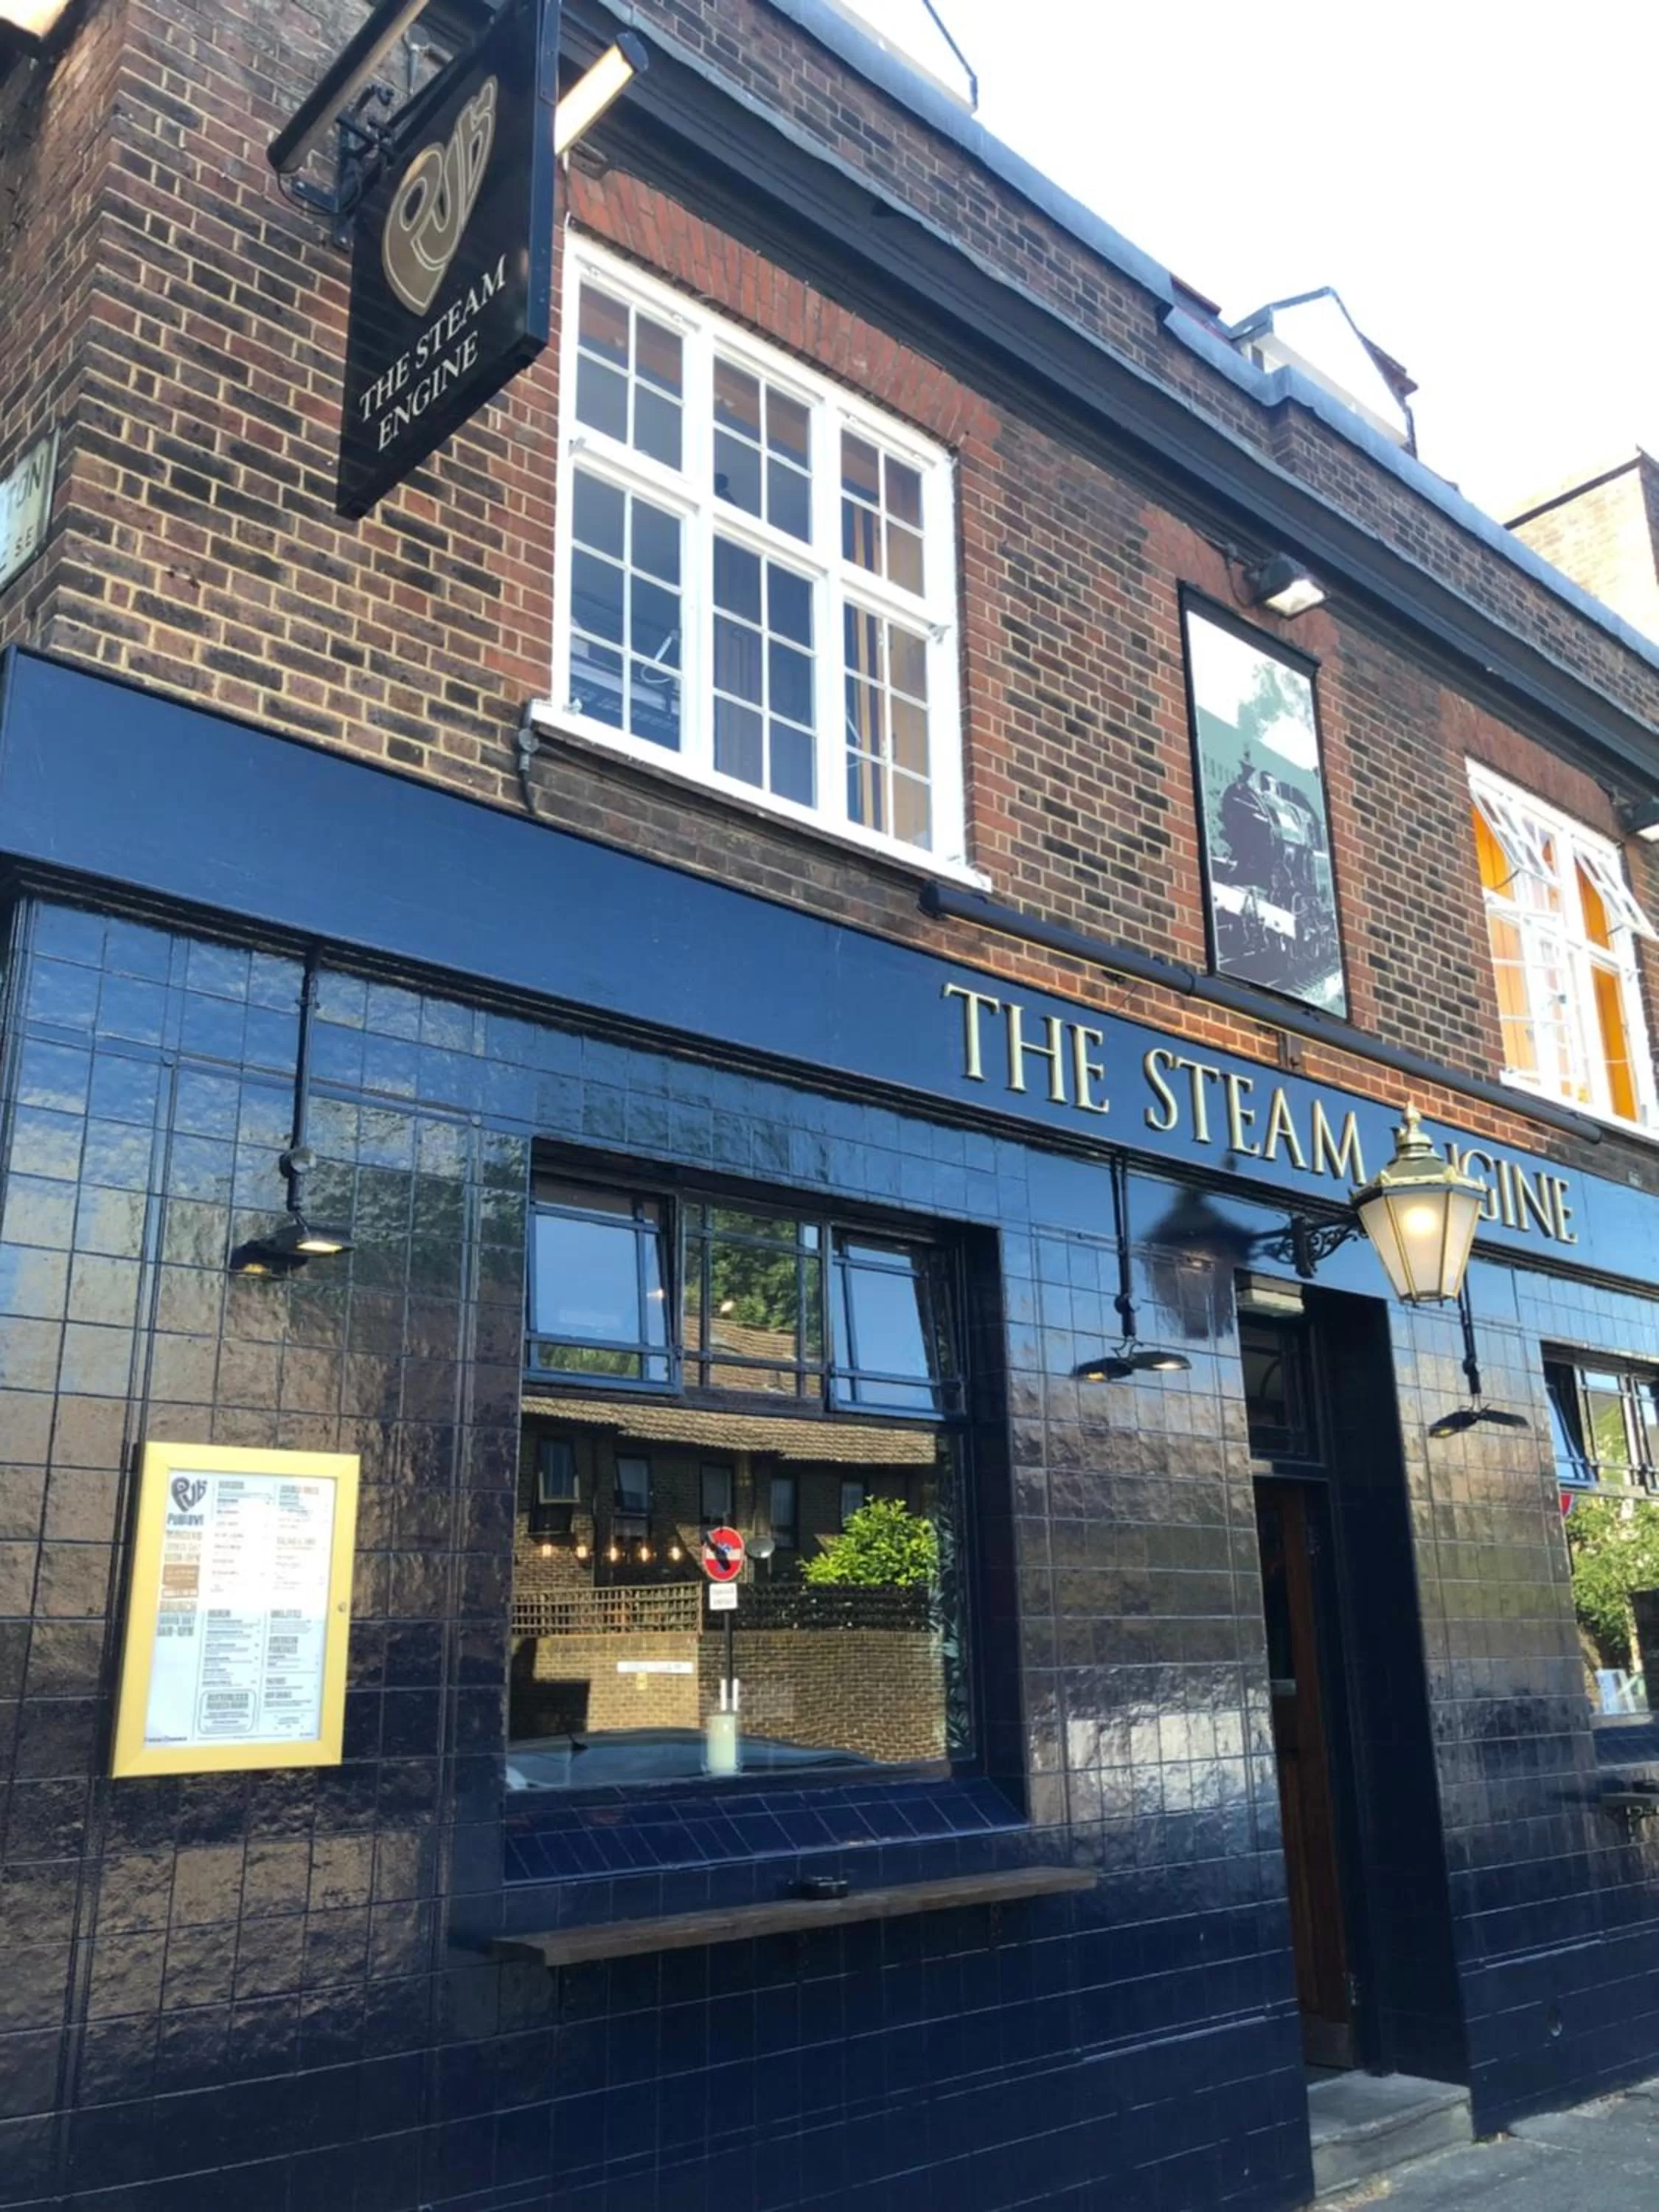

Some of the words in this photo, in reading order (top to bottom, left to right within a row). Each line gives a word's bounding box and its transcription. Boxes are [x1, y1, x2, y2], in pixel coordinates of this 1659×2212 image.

[359, 352, 411, 423] THE
[415, 253, 507, 370] STEAM
[378, 331, 479, 452] ENGINE
[942, 983, 1110, 1115] THE
[1144, 1048, 1368, 1186] STEAM
[1390, 1127, 1579, 1245] GINE
